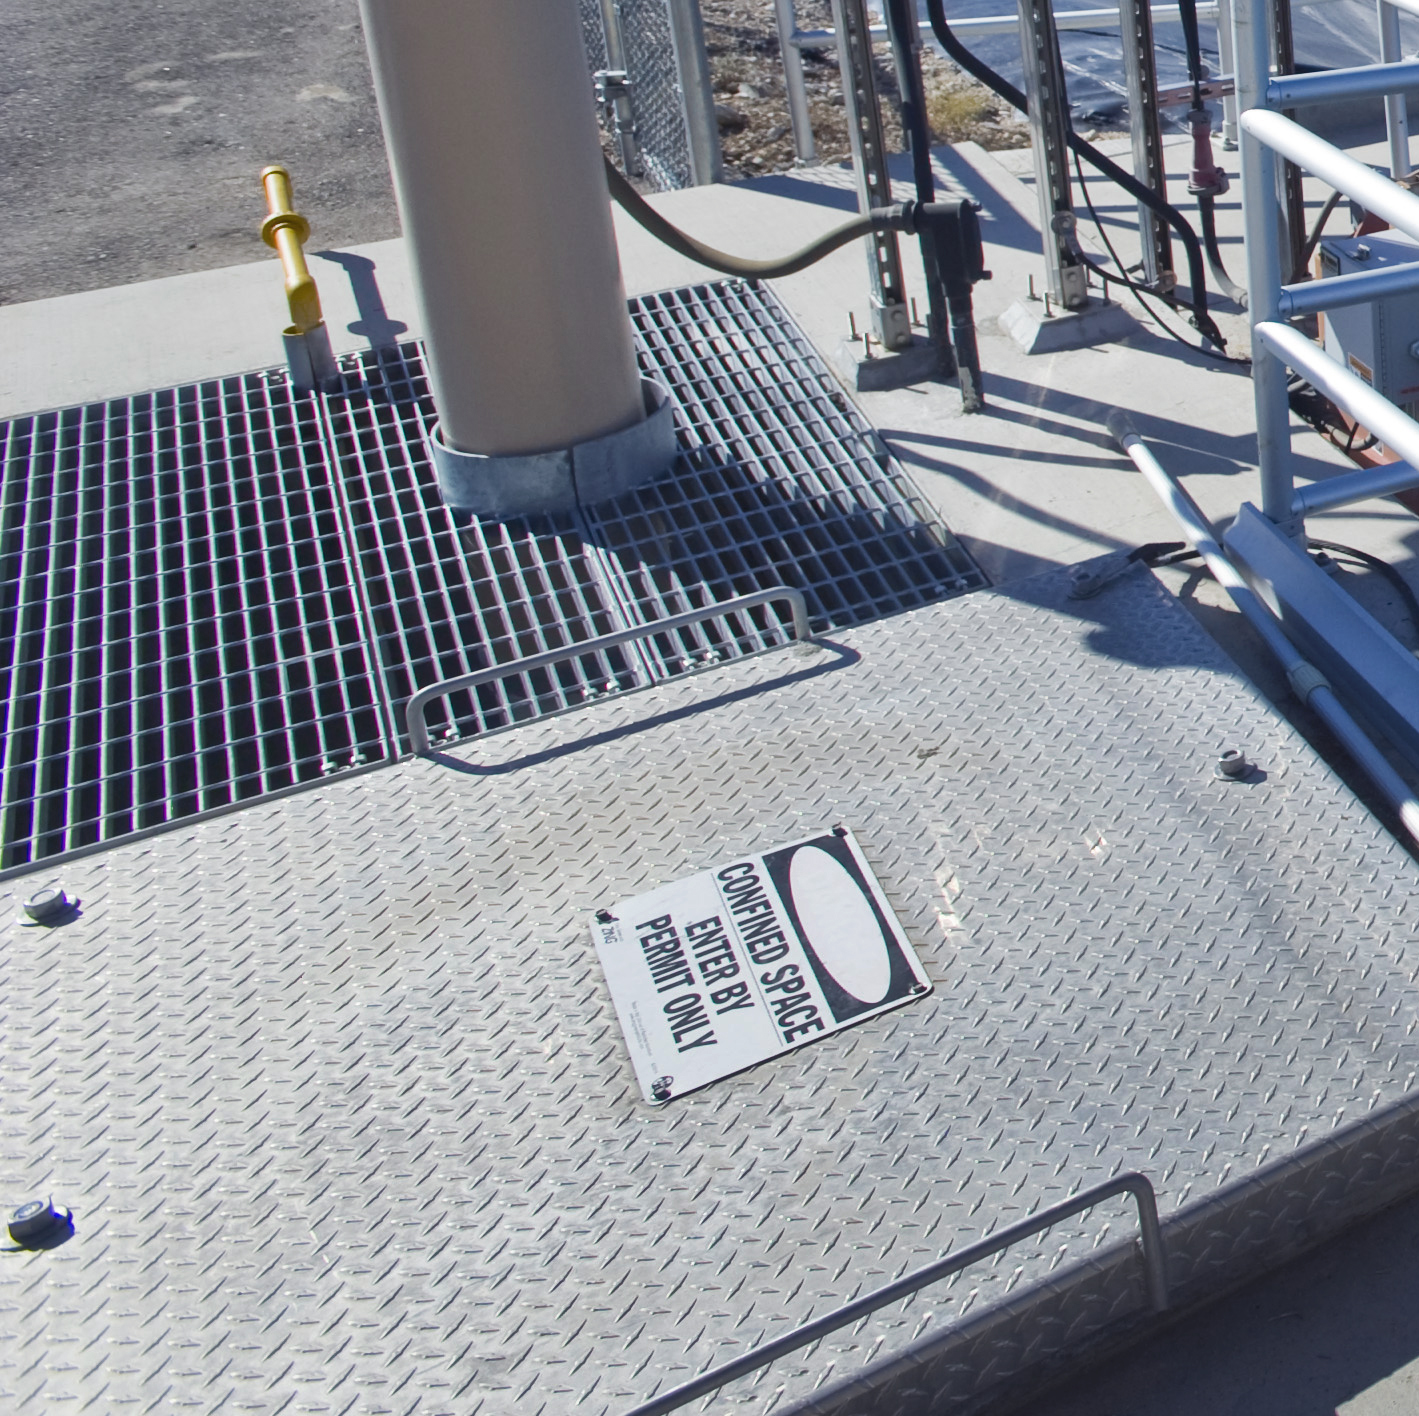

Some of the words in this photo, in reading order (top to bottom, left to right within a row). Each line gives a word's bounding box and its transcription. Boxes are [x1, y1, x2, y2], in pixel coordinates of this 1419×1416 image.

[601, 926, 618, 945] ZING
[635, 913, 695, 993] PERMIT
[684, 915, 741, 986] ENTER
[718, 862, 789, 965] CONFINED
[760, 964, 825, 1044] SPACE
[663, 993, 718, 1053] ONLY
[710, 981, 756, 1015] BY
